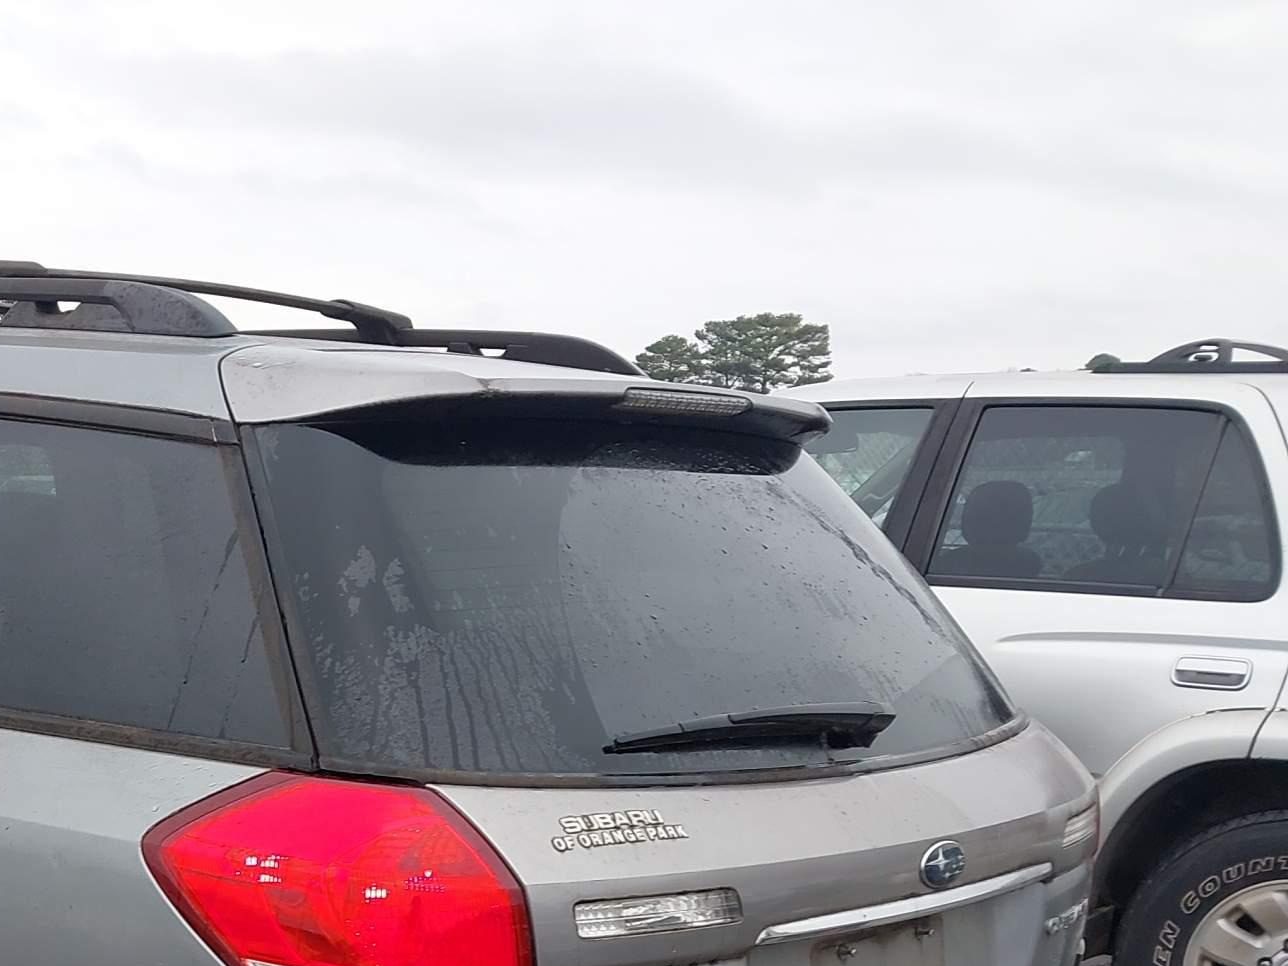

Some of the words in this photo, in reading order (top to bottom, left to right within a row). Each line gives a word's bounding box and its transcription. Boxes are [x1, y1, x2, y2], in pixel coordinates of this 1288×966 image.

[559, 809, 664, 834] SUBARU
[551, 836, 575, 852] OF
[577, 827, 647, 849] ORANGE
[646, 824, 689, 841] PARK
